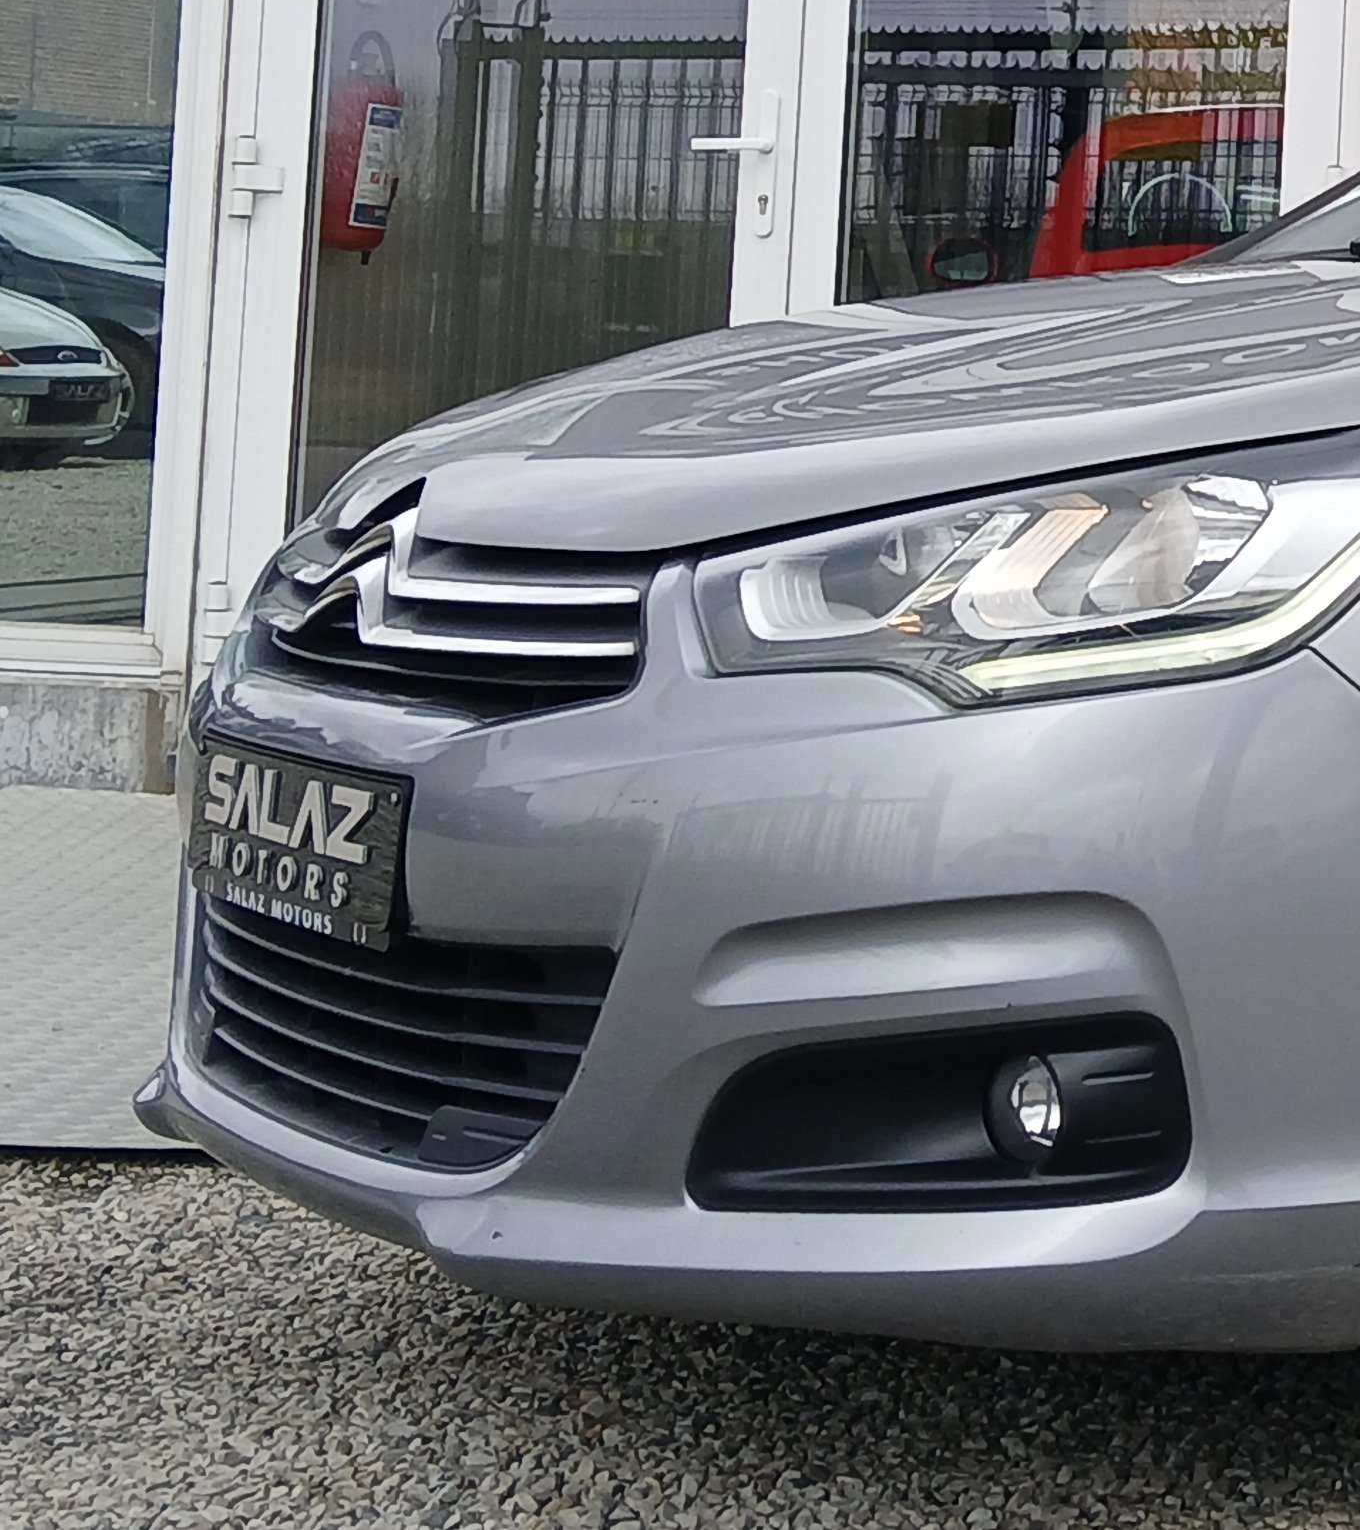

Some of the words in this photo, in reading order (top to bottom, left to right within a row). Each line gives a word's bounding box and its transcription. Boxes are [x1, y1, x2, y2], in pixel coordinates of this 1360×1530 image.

[204, 753, 375, 865] SALAZ
[208, 832, 351, 909] MOTORS
[225, 882, 267, 914] SALAZ
[270, 898, 333, 935] MOTORS
